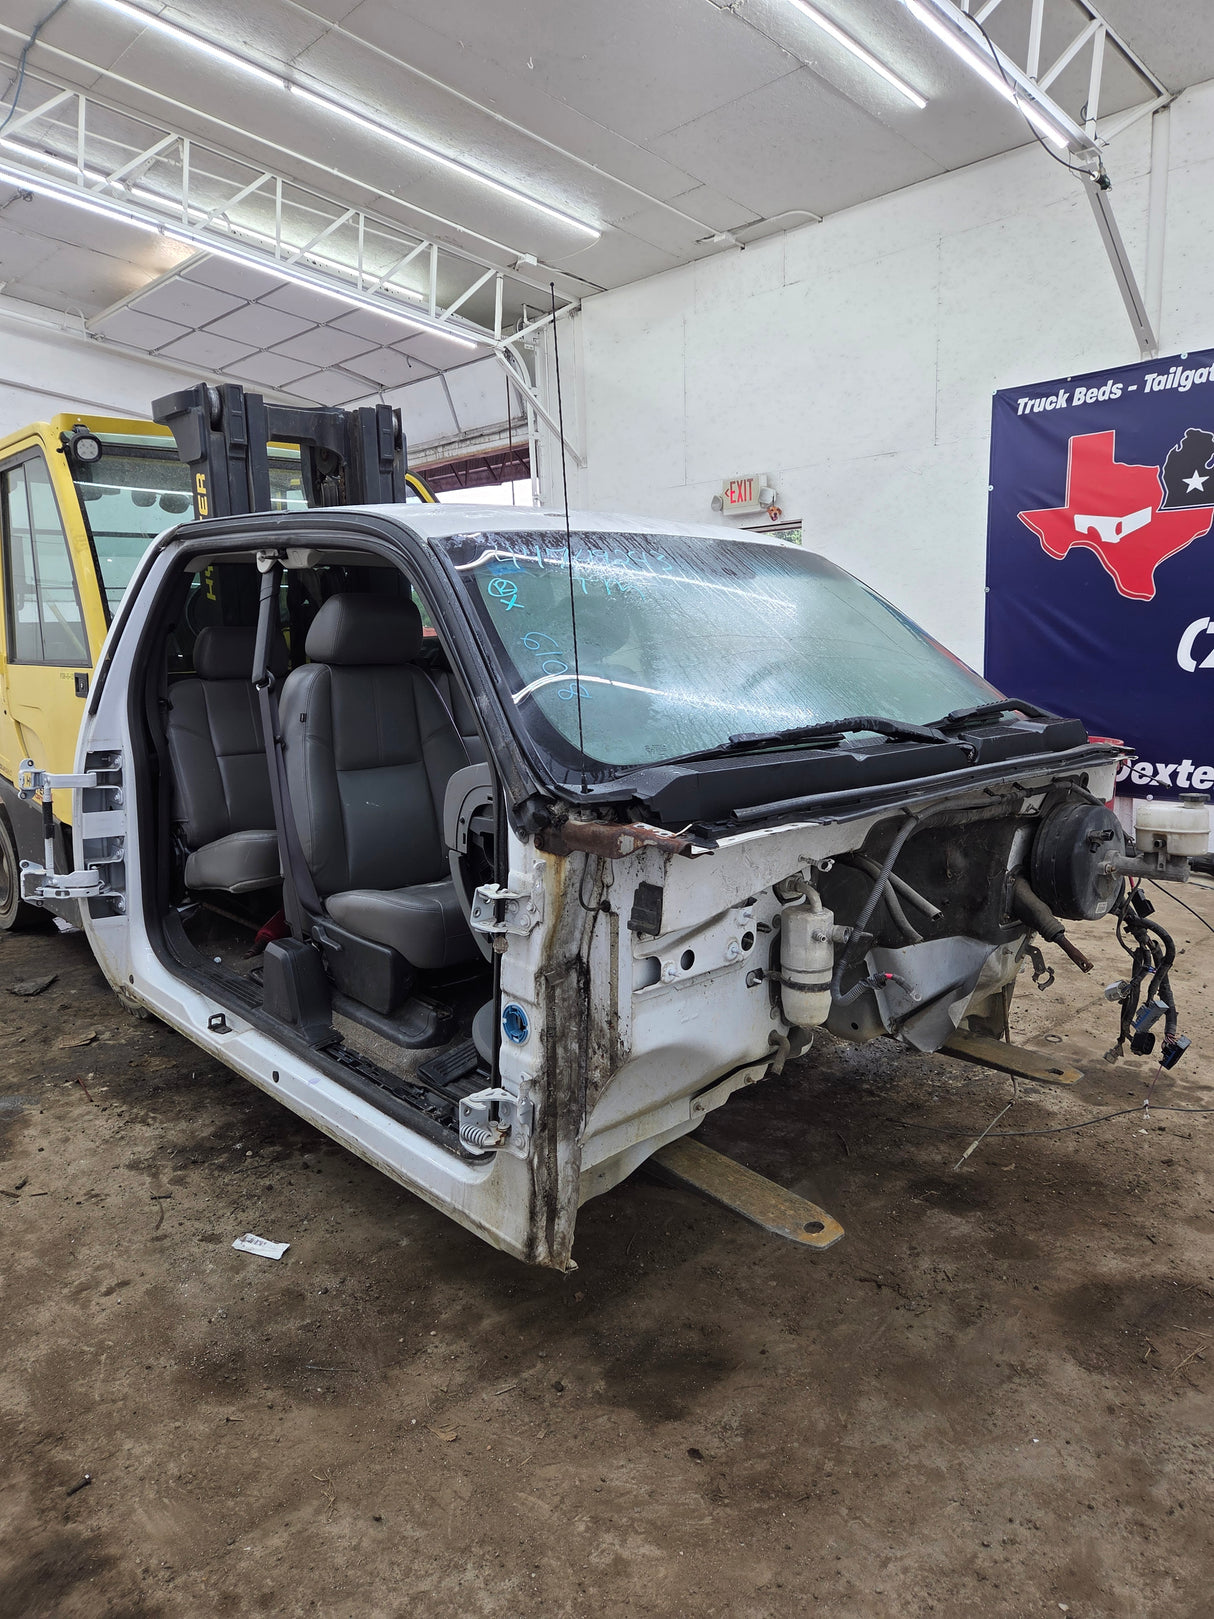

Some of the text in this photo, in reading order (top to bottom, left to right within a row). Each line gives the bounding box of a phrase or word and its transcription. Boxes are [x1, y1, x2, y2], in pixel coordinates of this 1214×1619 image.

[1017, 389, 1068, 415] Truck
[1072, 380, 1122, 406] Beds
[729, 478, 754, 504] EXIT
